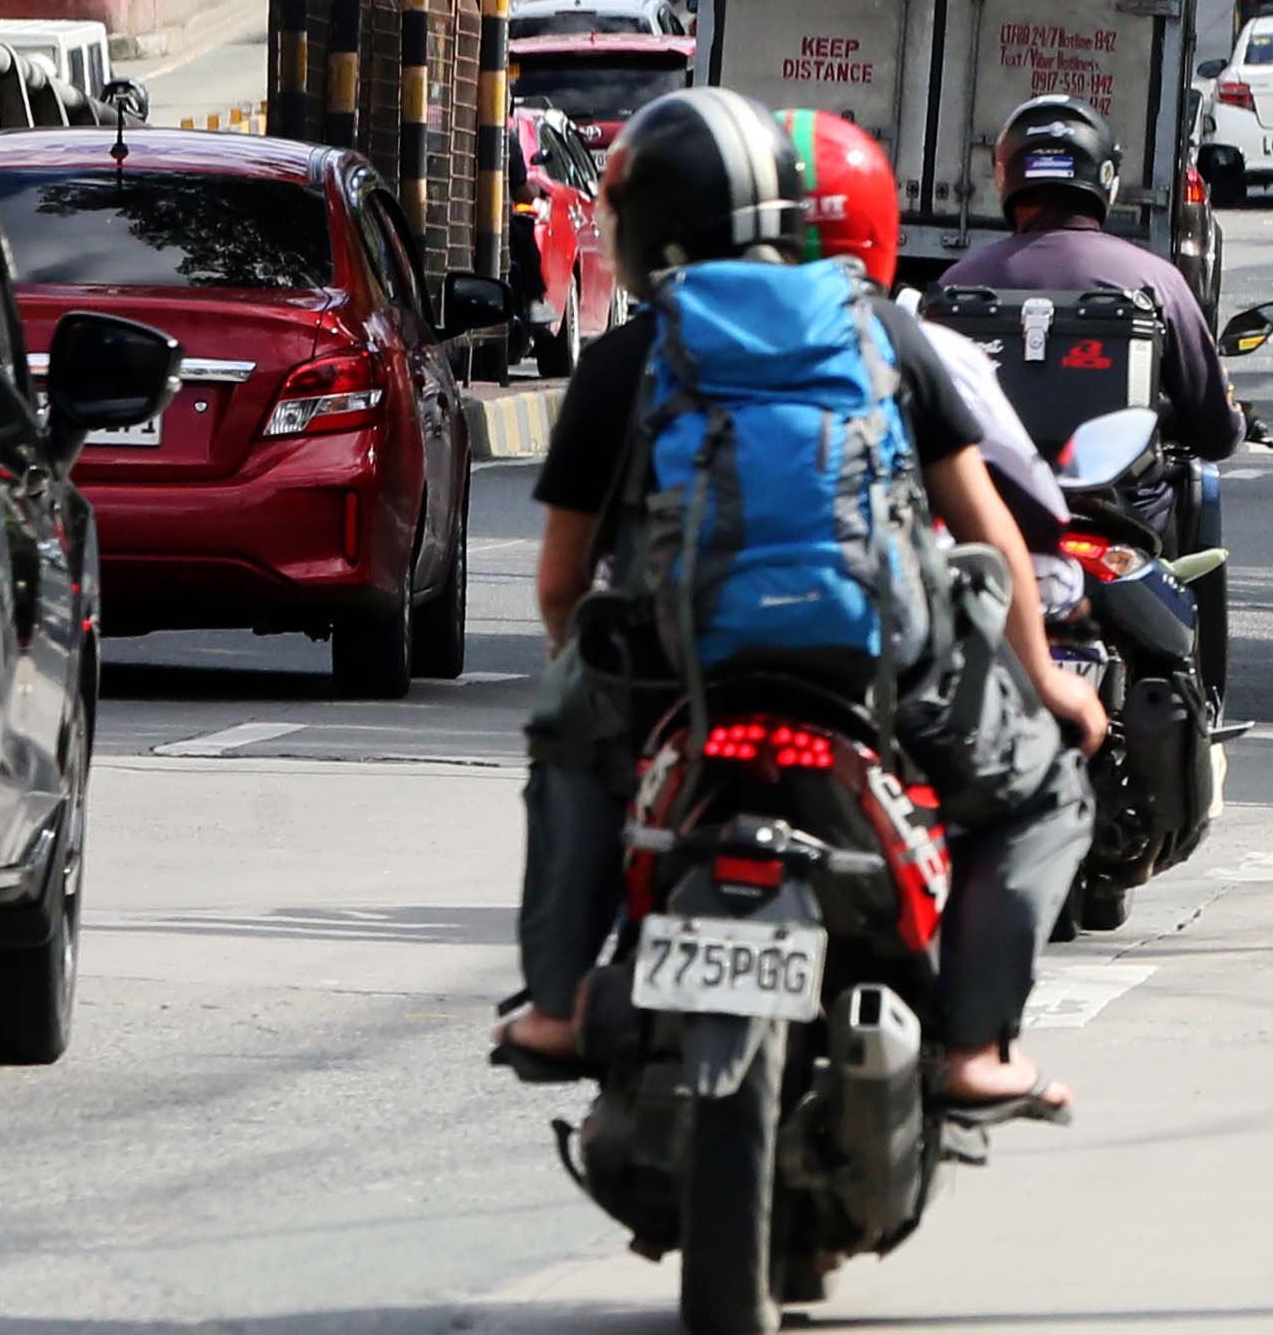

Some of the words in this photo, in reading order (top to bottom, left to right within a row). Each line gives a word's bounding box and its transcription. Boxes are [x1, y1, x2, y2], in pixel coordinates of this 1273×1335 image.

[801, 36, 860, 59] KEEP
[782, 58, 873, 84] DISTANCE
[645, 936, 809, 997] 775PGG
